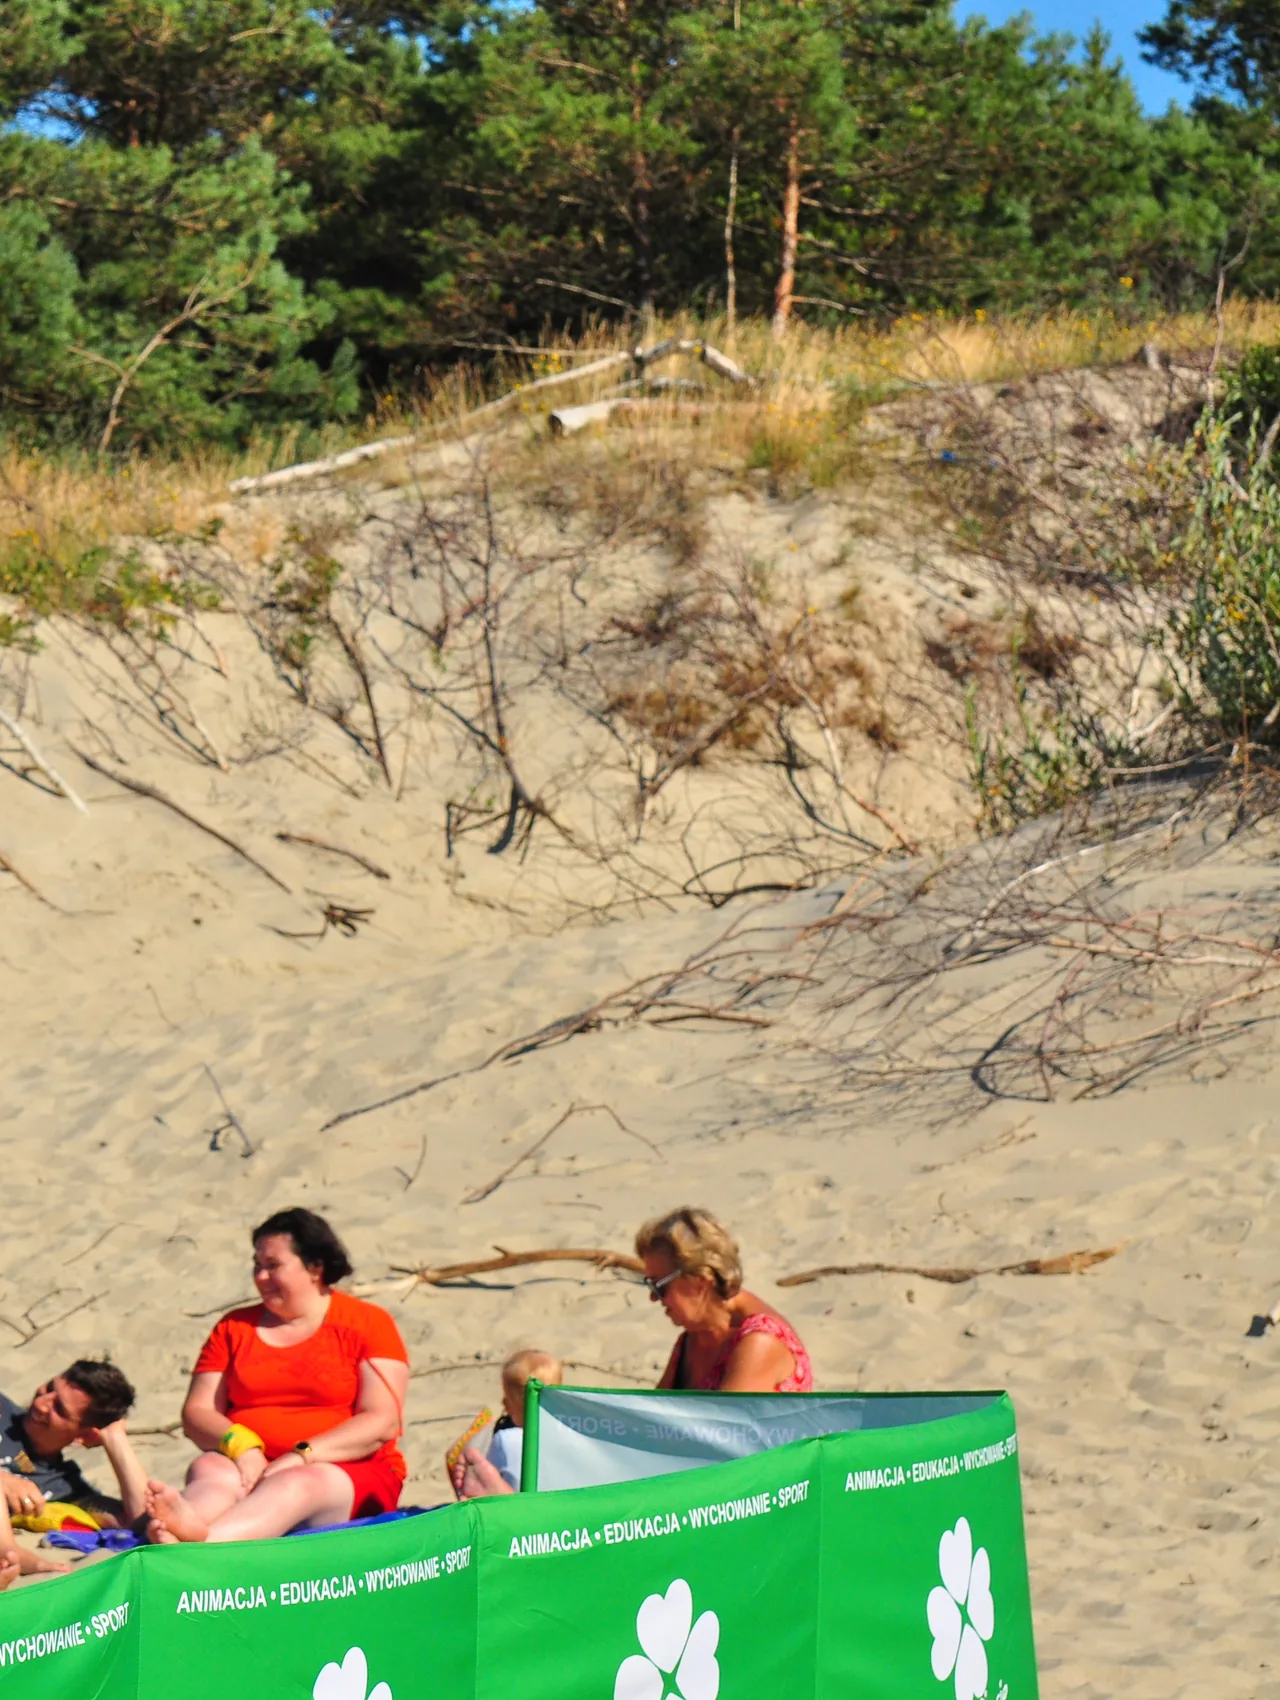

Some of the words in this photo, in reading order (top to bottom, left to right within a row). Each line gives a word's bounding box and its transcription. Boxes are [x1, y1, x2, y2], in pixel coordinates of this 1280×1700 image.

[845, 1466, 906, 1492] ANIMACJA
[912, 1455, 960, 1483] EDUKACJA
[508, 1527, 593, 1558] ANIMACJA
[603, 1512, 681, 1545] EDUKACJA
[688, 1492, 772, 1529] WYCHOWANIE
[778, 1480, 810, 1509] SPORT
[176, 1585, 267, 1614] ANIMACJA
[280, 1574, 357, 1606] EDUKACJA
[364, 1556, 441, 1593] WYCHOWANIE
[445, 1545, 472, 1574] SPORT
[91, 1601, 130, 1638] SPORT
